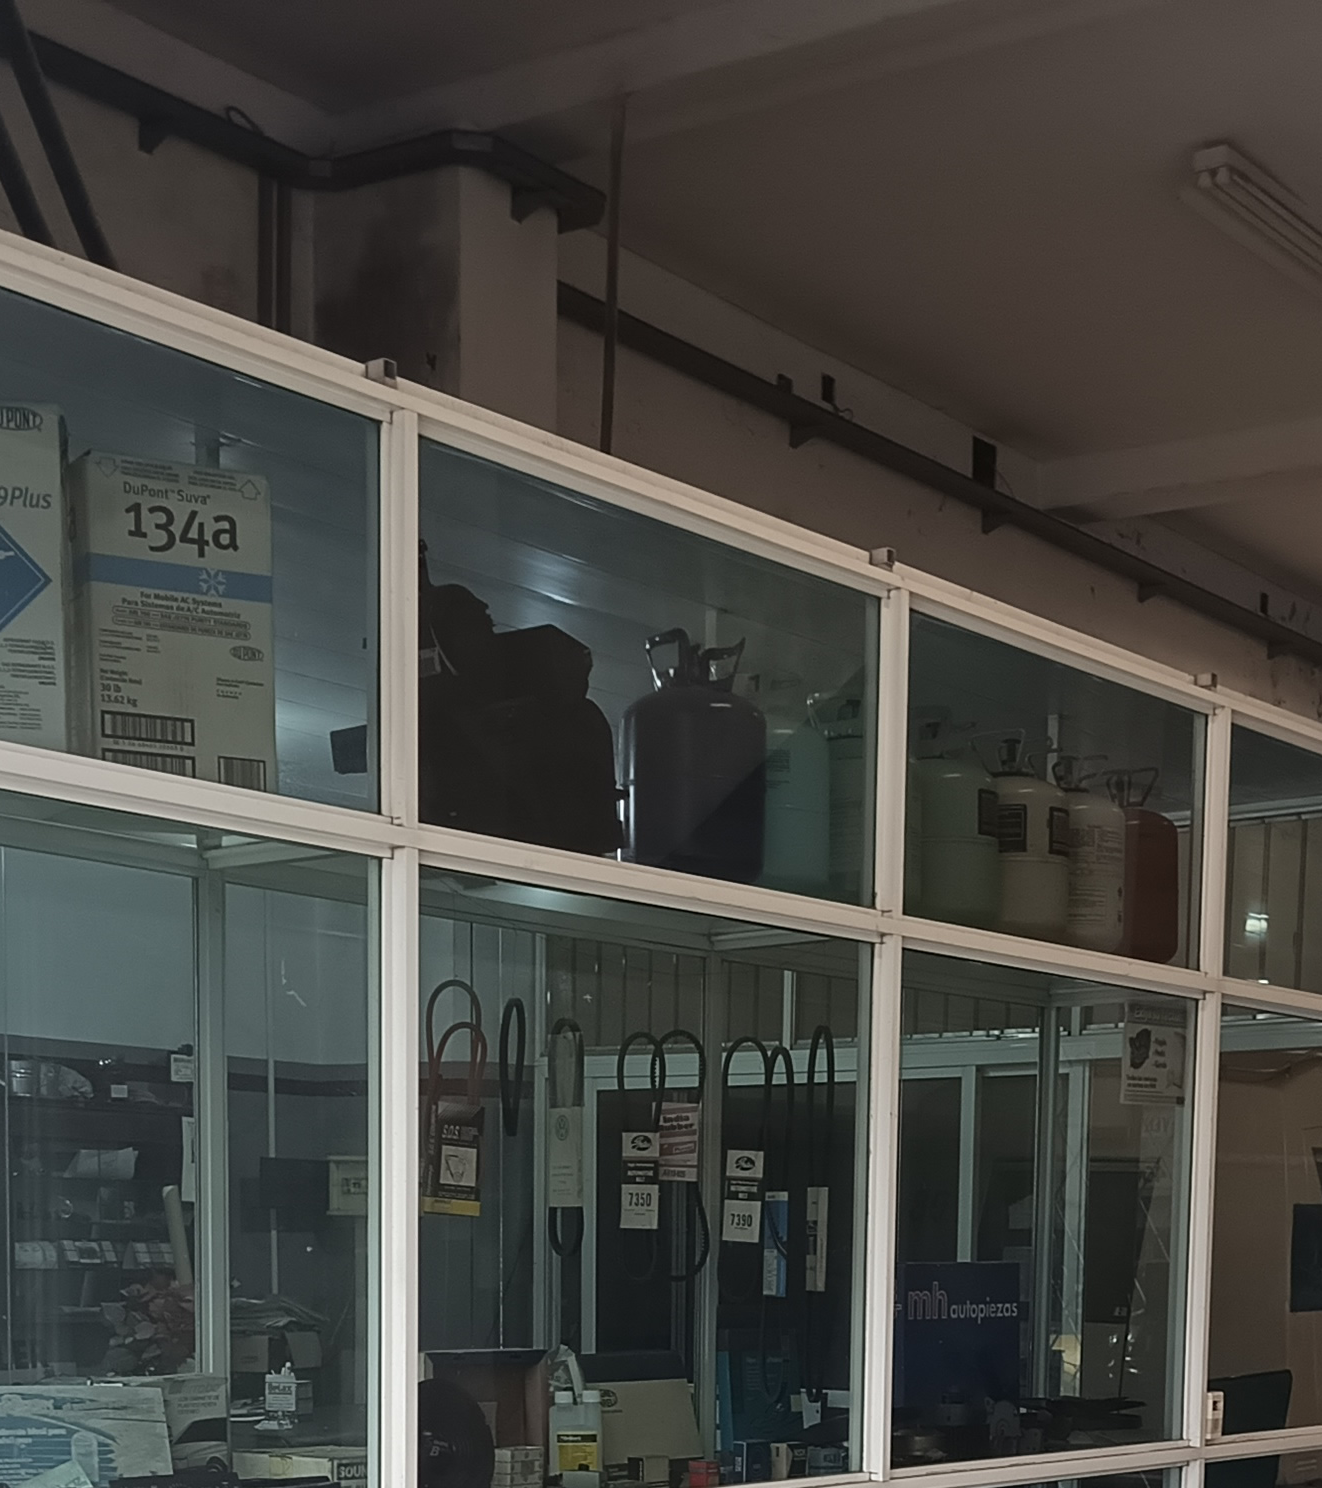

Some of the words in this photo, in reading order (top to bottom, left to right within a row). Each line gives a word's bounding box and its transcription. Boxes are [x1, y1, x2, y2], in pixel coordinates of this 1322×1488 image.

[124, 502, 240, 559] 134a
[662, 1114, 690, 1124] India
[628, 1192, 652, 1207] 7350
[730, 1212, 754, 1228] 7390
[908, 1281, 949, 1320] mh
[950, 1297, 1018, 1324] autopiezas
